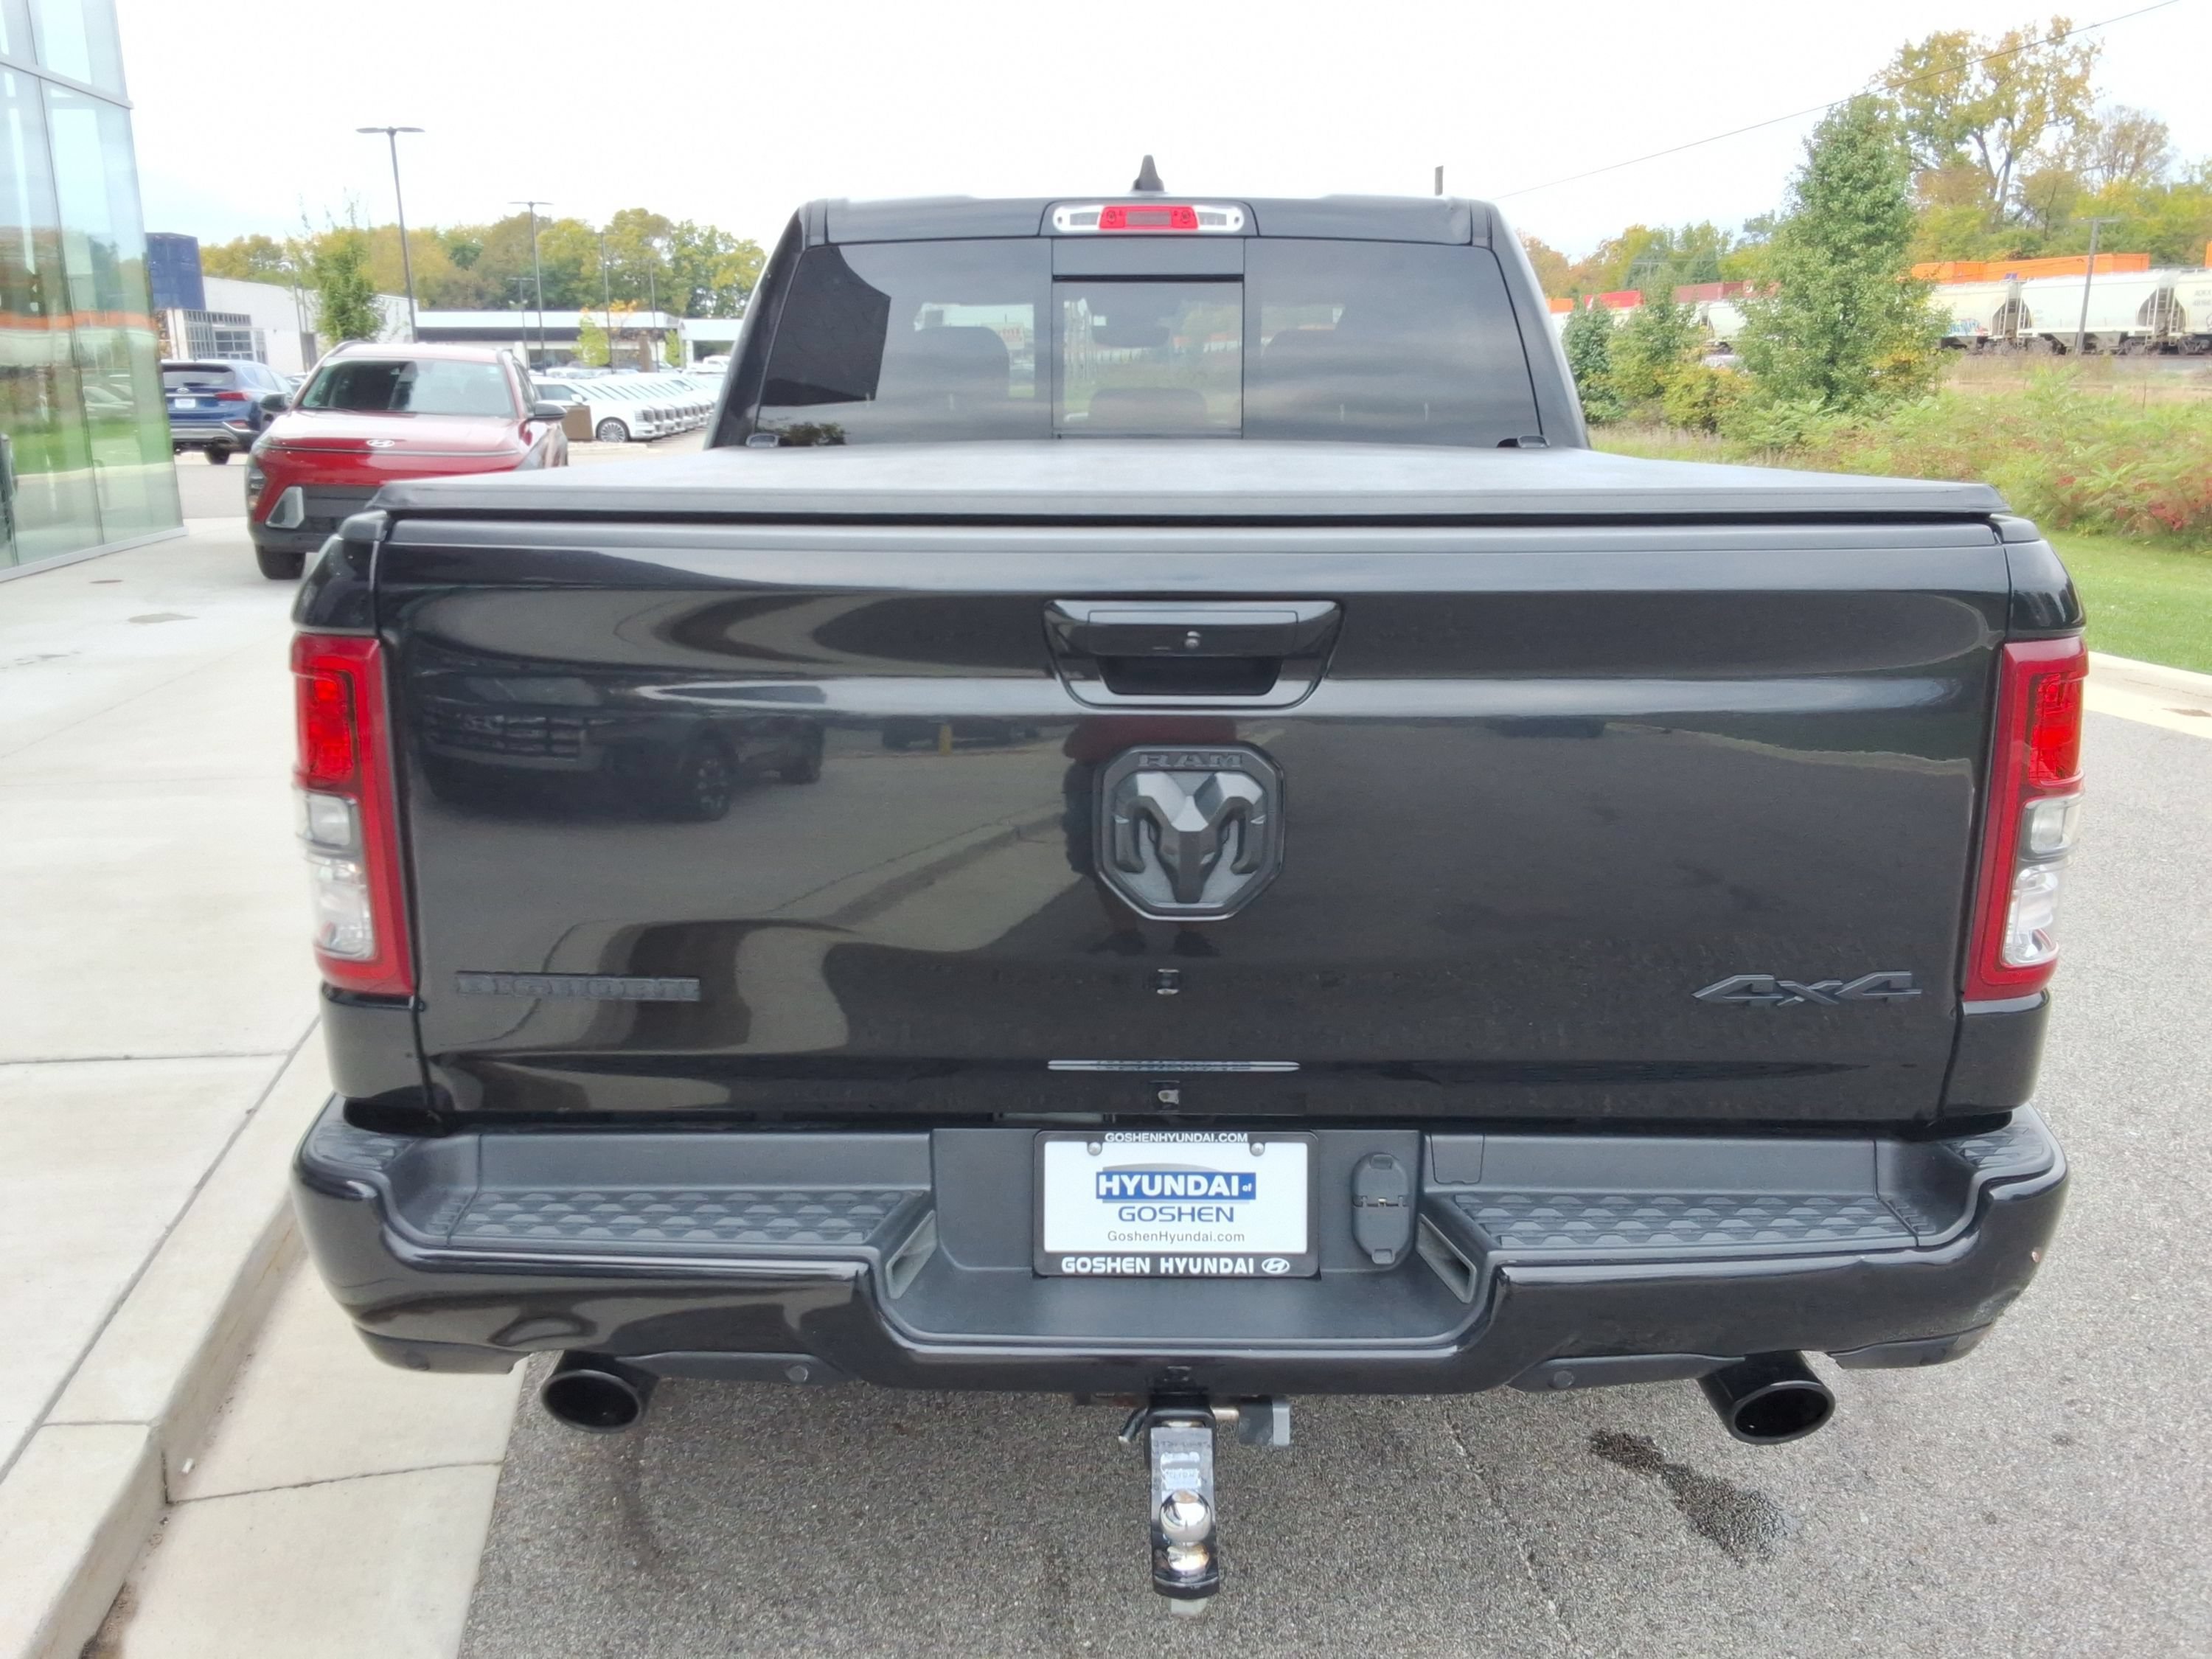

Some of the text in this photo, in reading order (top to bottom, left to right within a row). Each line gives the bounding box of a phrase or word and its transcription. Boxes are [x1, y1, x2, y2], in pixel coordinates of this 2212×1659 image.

[1138, 754, 1243, 768] RAM
[1105, 1133, 1248, 1144] GOSHENHYUNDAI.COM
[1098, 1175, 1252, 1197] HYUNDAI of
[1118, 1206, 1234, 1222] GOSHEN
[1107, 1231, 1245, 1245] GoshenHyundai.com
[1061, 1256, 1254, 1275] GOSHEN HYUNDAI
